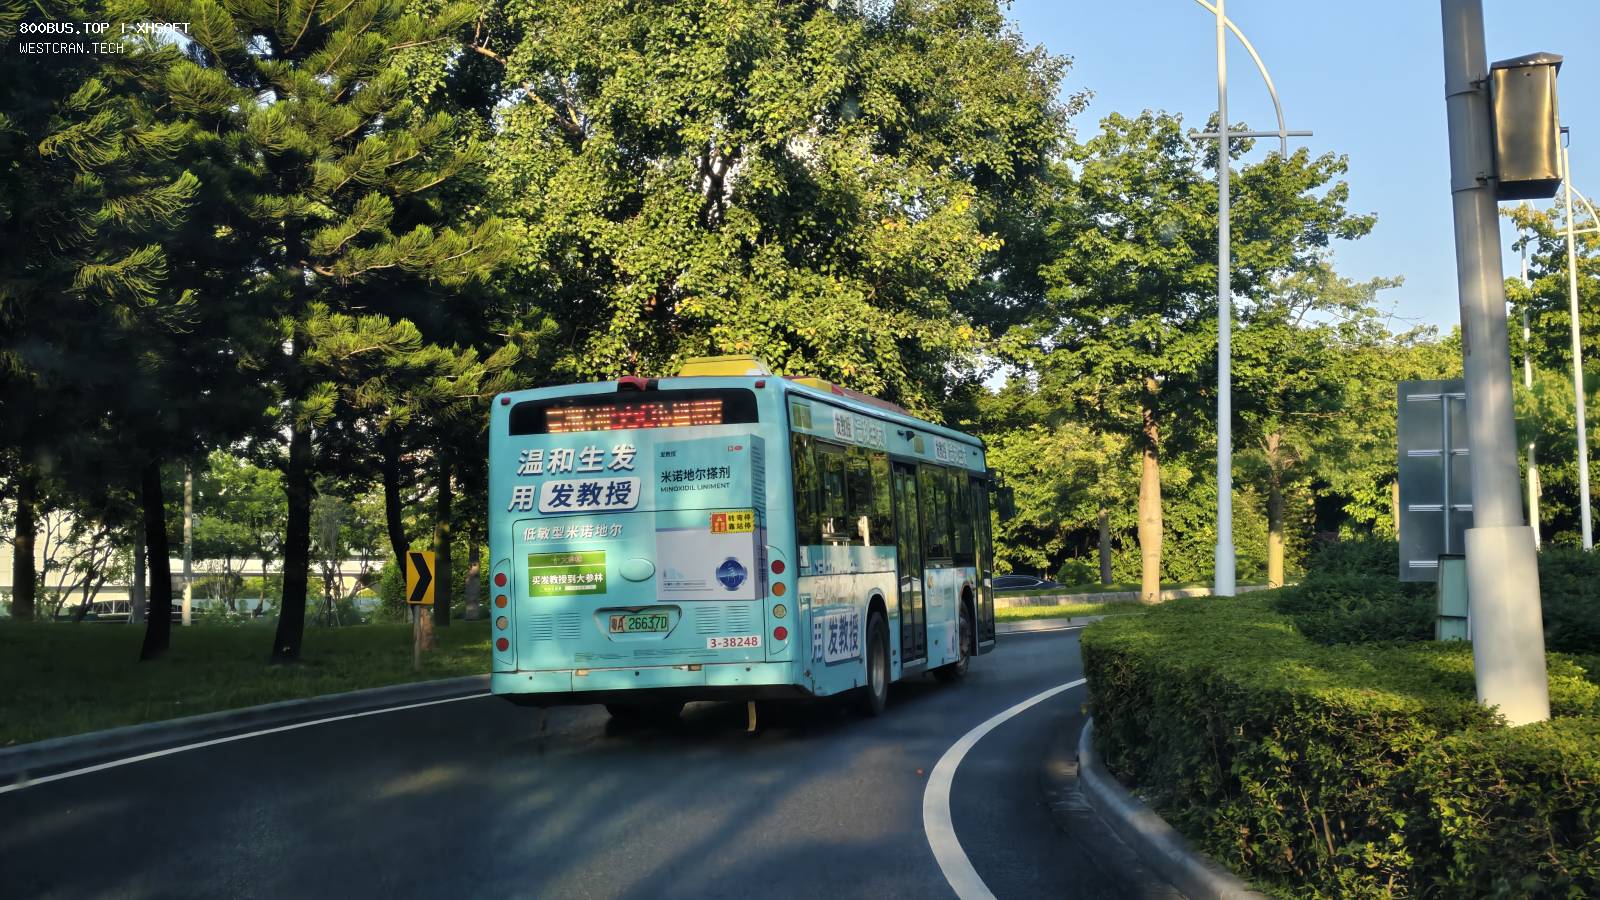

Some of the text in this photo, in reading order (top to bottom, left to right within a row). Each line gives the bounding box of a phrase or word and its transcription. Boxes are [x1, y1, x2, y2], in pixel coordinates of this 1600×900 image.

[517, 444, 637, 476] 温和生发
[660, 465, 731, 483] 米诺地尔搽剂
[508, 480, 632, 512] 用 发教授
[660, 482, 731, 493] MINOXIDIL LINIMENT
[523, 522, 624, 541] 低敏型米诺地尔
[531, 572, 604, 585] 买发教授到大参林
[628, 616, 667, 630] 26637D
[710, 636, 758, 648] 3-38248
[828, 612, 859, 656] 发教授
